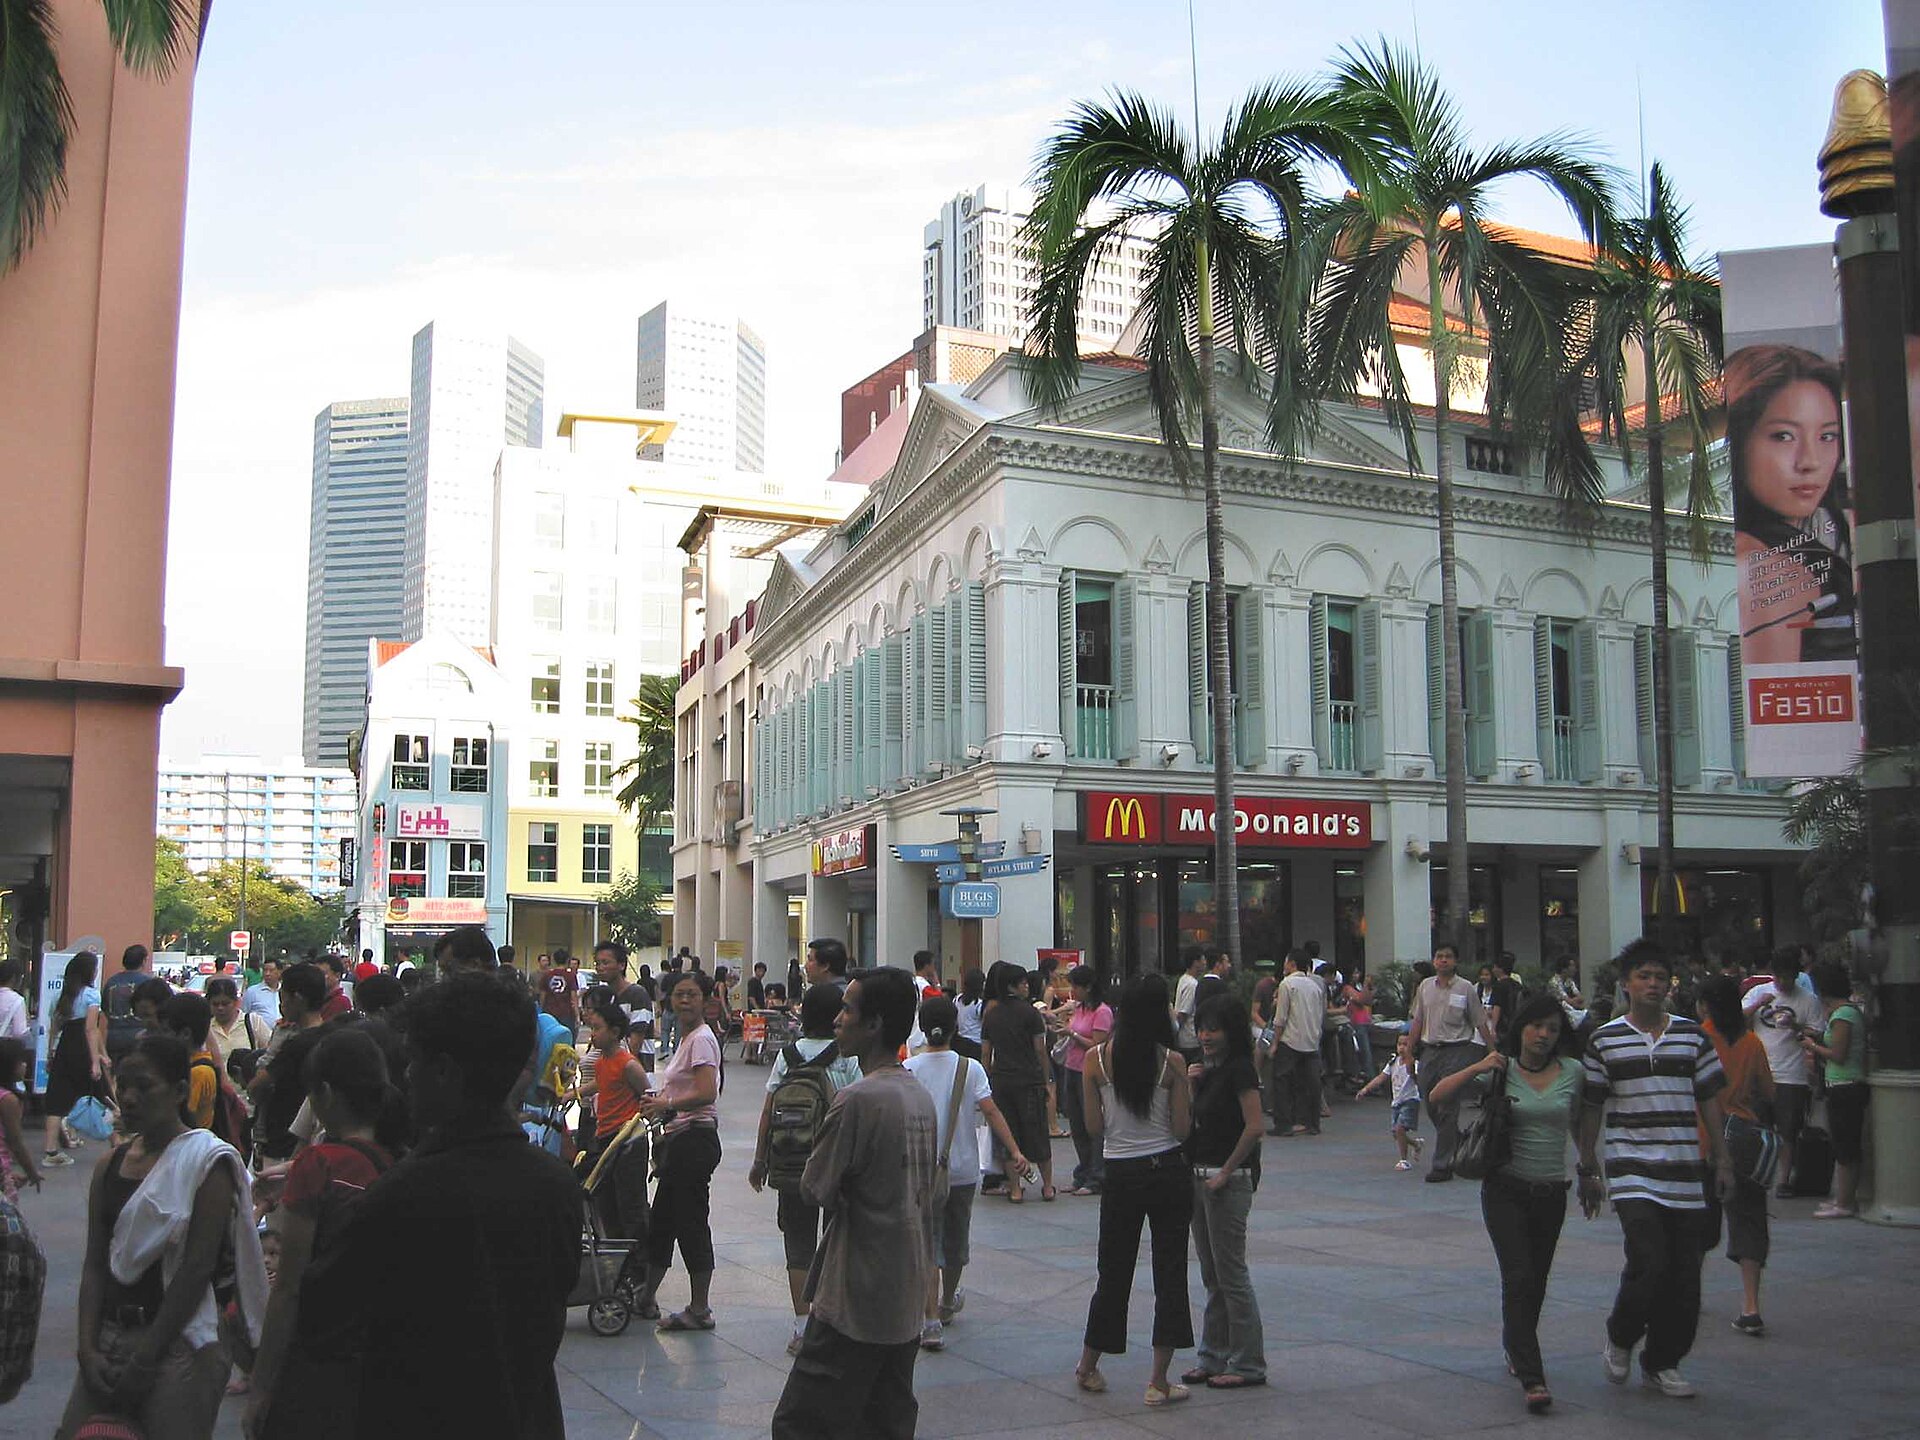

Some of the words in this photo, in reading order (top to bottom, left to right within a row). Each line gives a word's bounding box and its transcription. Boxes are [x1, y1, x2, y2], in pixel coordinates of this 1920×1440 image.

[1824, 520, 1836, 534] &
[1804, 556, 1831, 573] my
[1759, 690, 1843, 717] Fasio
[1012, 860, 1034, 871] STREET
[960, 892, 993, 900] BUGIS
